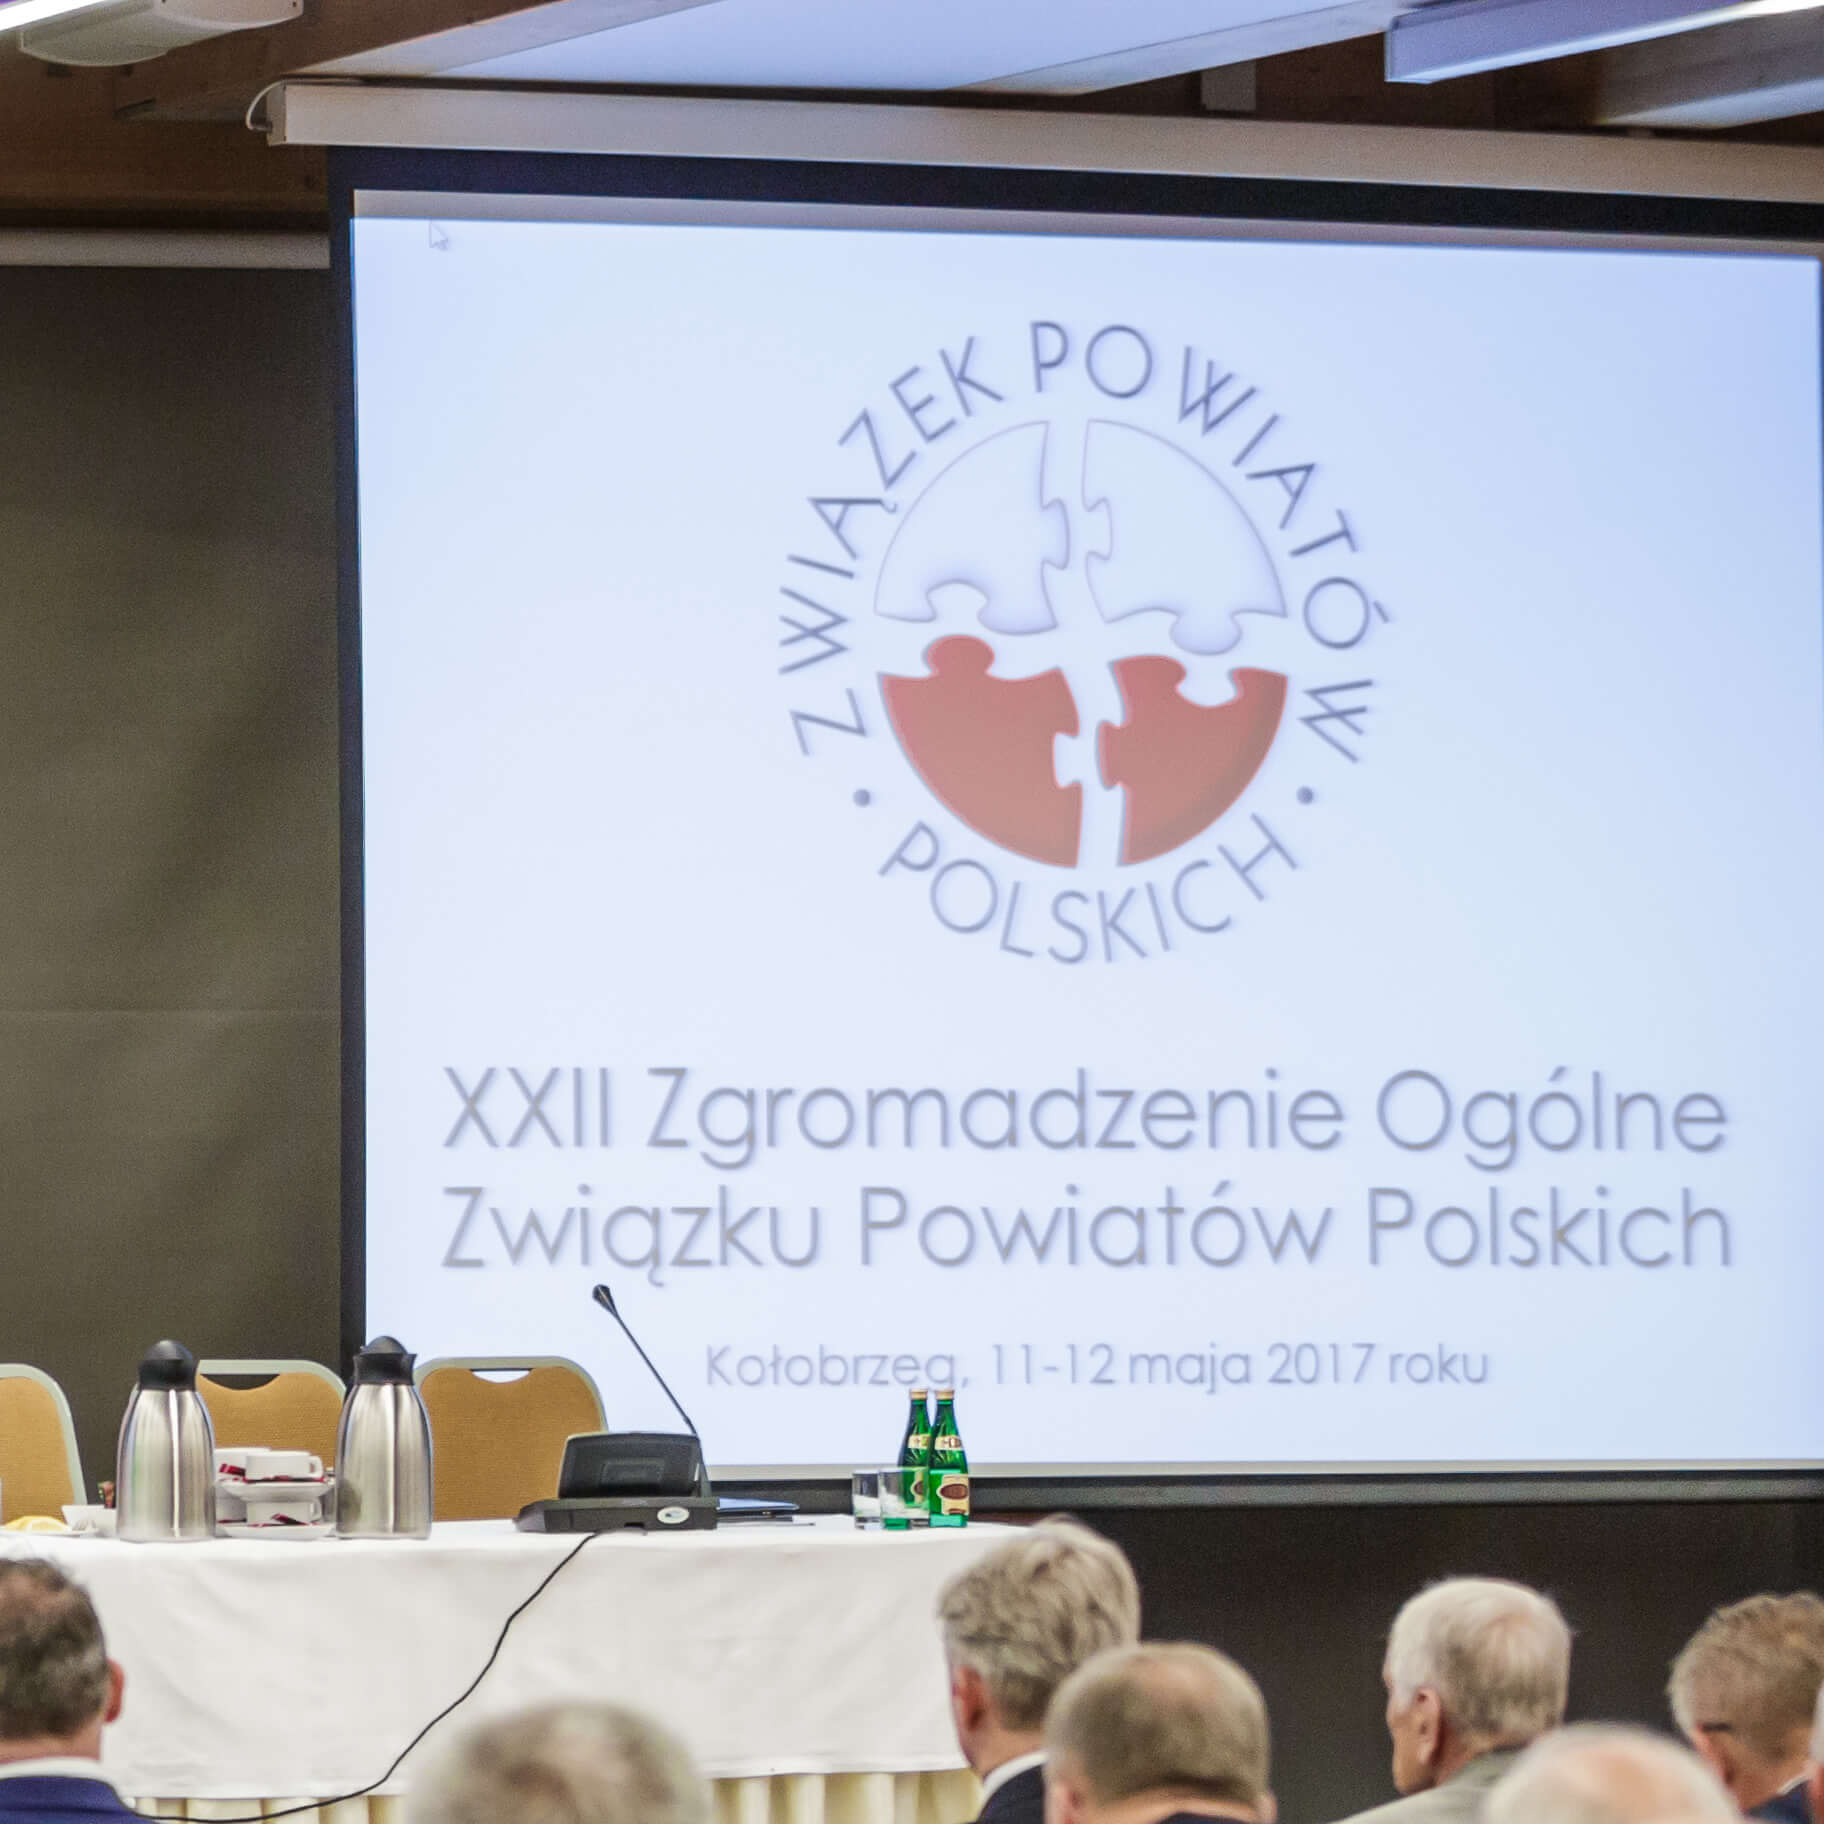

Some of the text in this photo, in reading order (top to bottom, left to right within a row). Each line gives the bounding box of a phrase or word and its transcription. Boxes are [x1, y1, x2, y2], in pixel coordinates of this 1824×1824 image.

[778, 319, 1392, 764] ZWIĄZEK POWIATÓW
[878, 811, 1299, 965] POLSKICH
[442, 1064, 1729, 1173] XXII Zgromadzenie Ogólne
[440, 1179, 1732, 1287] Związku Powiatów Polskich
[990, 1342, 1118, 1386] 11-12
[1128, 1344, 1254, 1396] maja
[1267, 1342, 1378, 1386] 2017
[1388, 1343, 1490, 1386] roku
